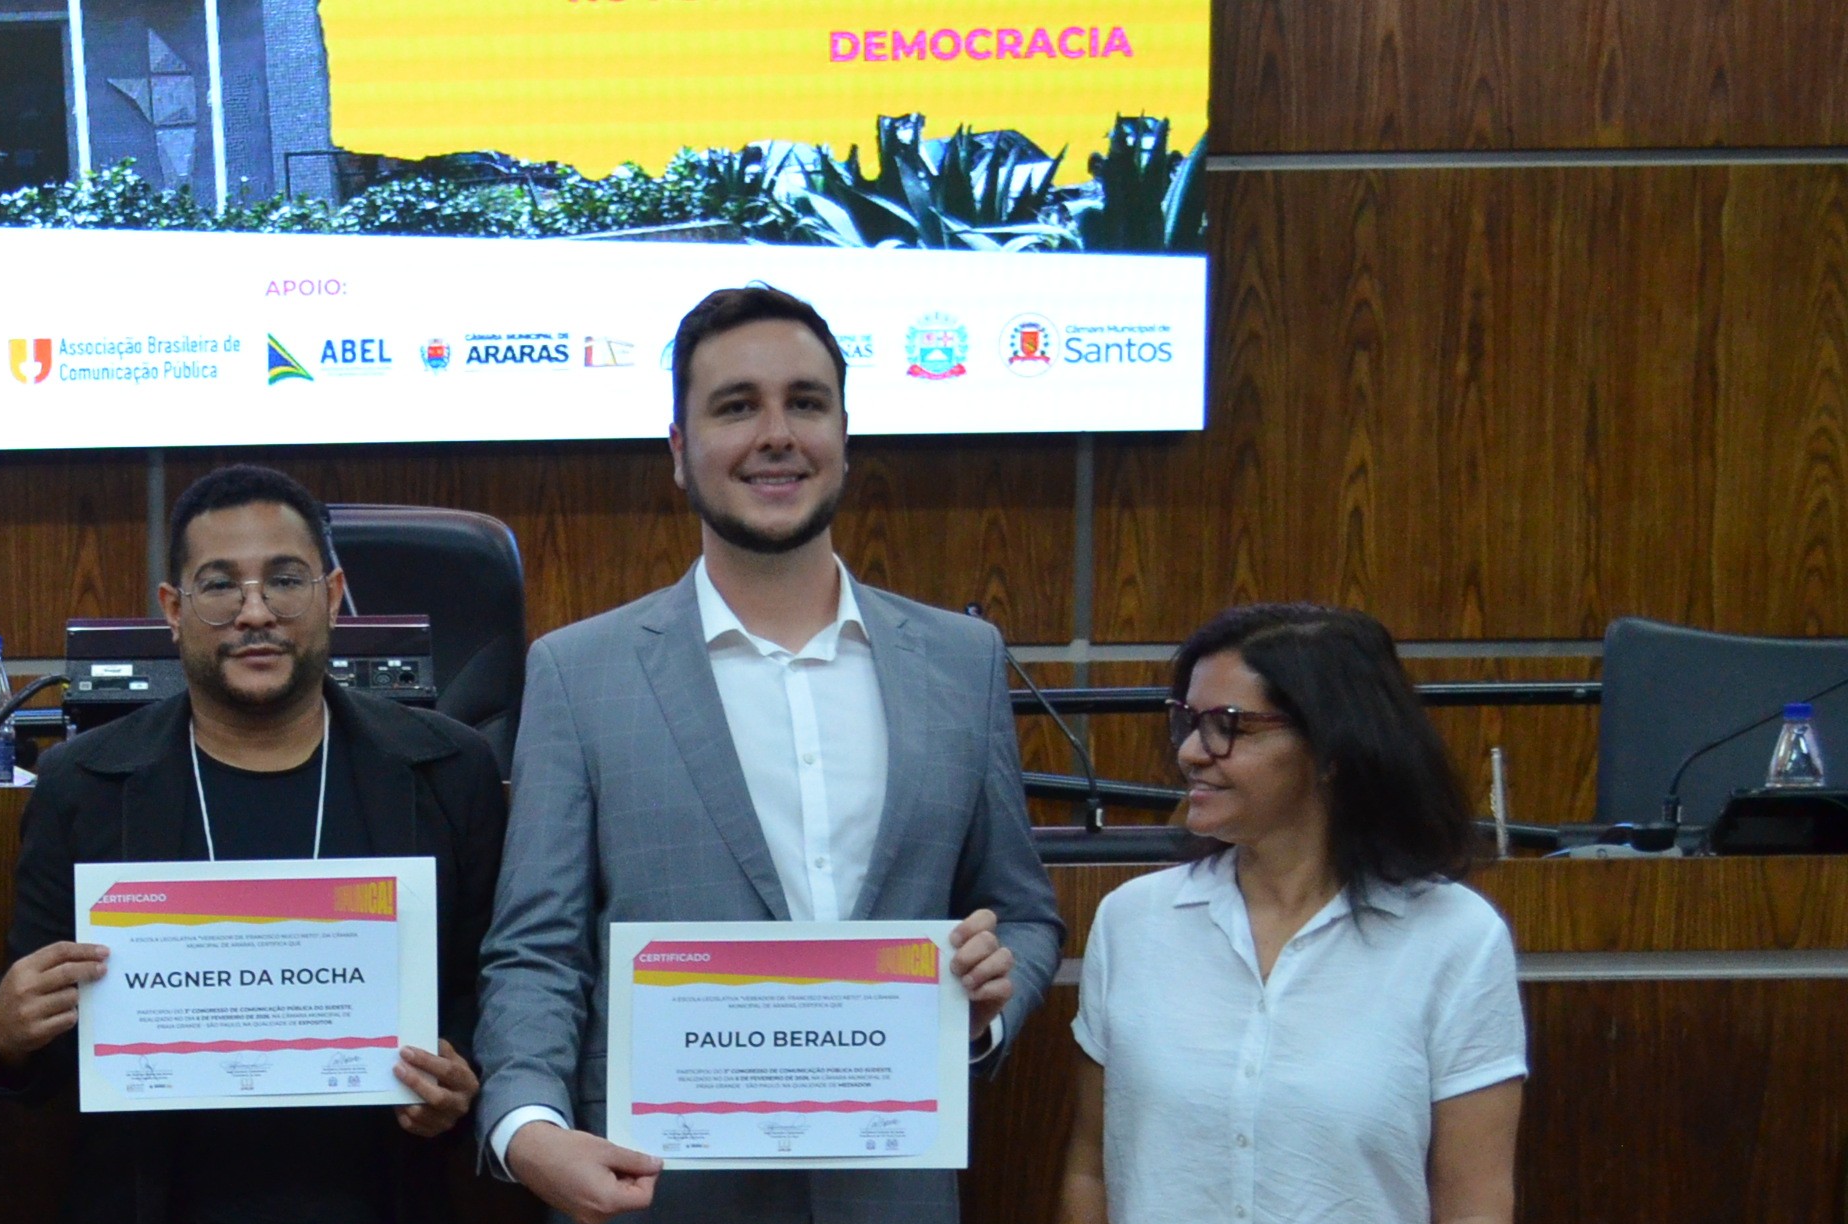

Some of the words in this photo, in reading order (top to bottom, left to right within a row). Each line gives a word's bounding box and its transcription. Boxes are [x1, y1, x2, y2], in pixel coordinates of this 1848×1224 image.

[830, 27, 1134, 62] DEMOCRACIA
[265, 279, 347, 297] APOIO:
[59, 335, 142, 359] Associação
[148, 335, 218, 354] Brasileira
[224, 335, 241, 352] de
[320, 338, 392, 364] ABEL
[465, 344, 570, 364] ARARAS
[1064, 337, 1172, 363] Santos
[59, 362, 159, 384] Comunicação
[164, 361, 218, 379] Pública
[639, 953, 711, 963] CERTIFICADO
[125, 970, 231, 989] WAGNER
[240, 969, 273, 986] DA
[282, 967, 365, 985] ROCHA
[685, 1031, 765, 1048] PAULO
[774, 1030, 886, 1047] BERALDO
